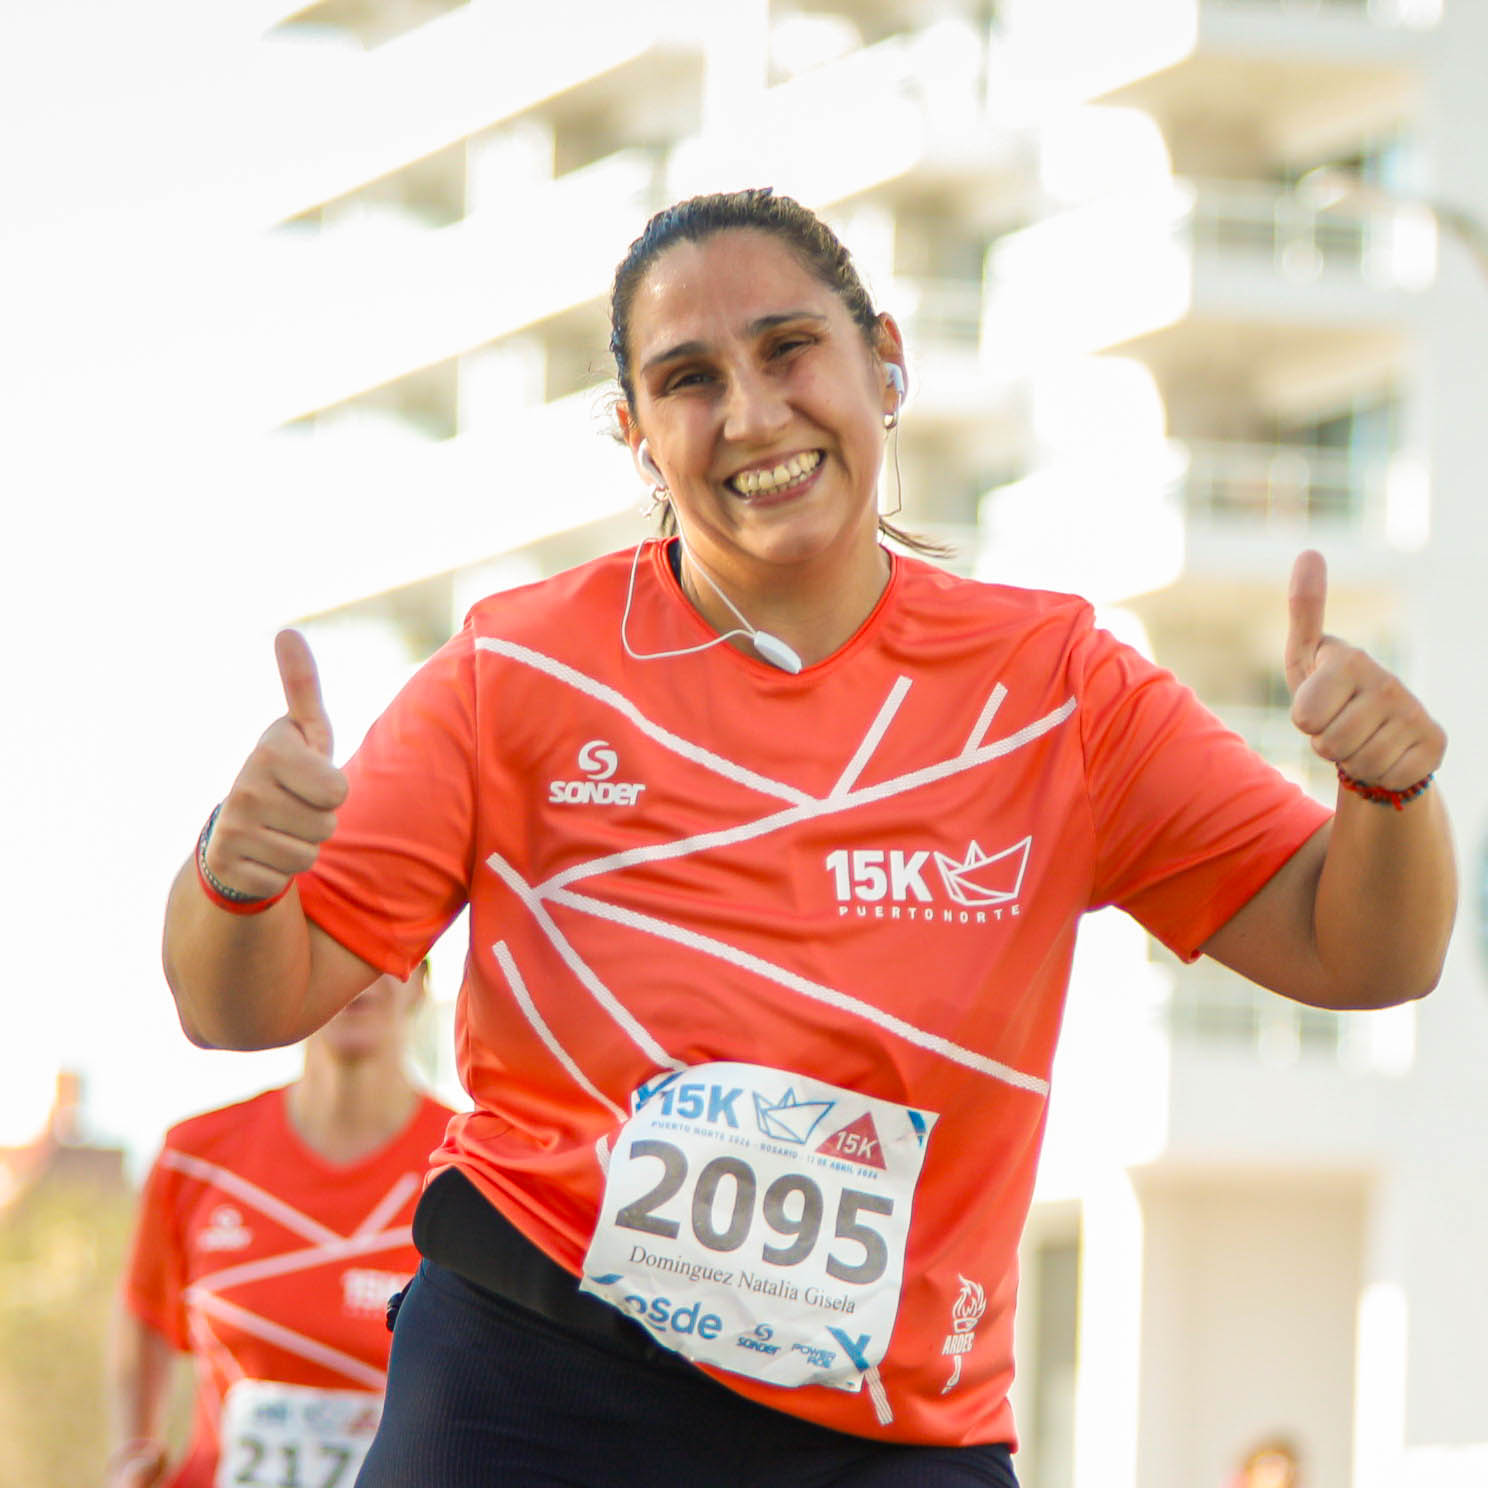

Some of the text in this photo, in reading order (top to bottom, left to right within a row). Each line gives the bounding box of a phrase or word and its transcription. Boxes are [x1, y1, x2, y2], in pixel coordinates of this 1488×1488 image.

[825, 849, 933, 902] 15K
[659, 1083, 744, 1129] 15K
[836, 1130, 878, 1160] 15K
[614, 1139, 895, 1286] 2095
[738, 1270, 799, 1301] Natalia
[804, 1286, 857, 1315] Gisela
